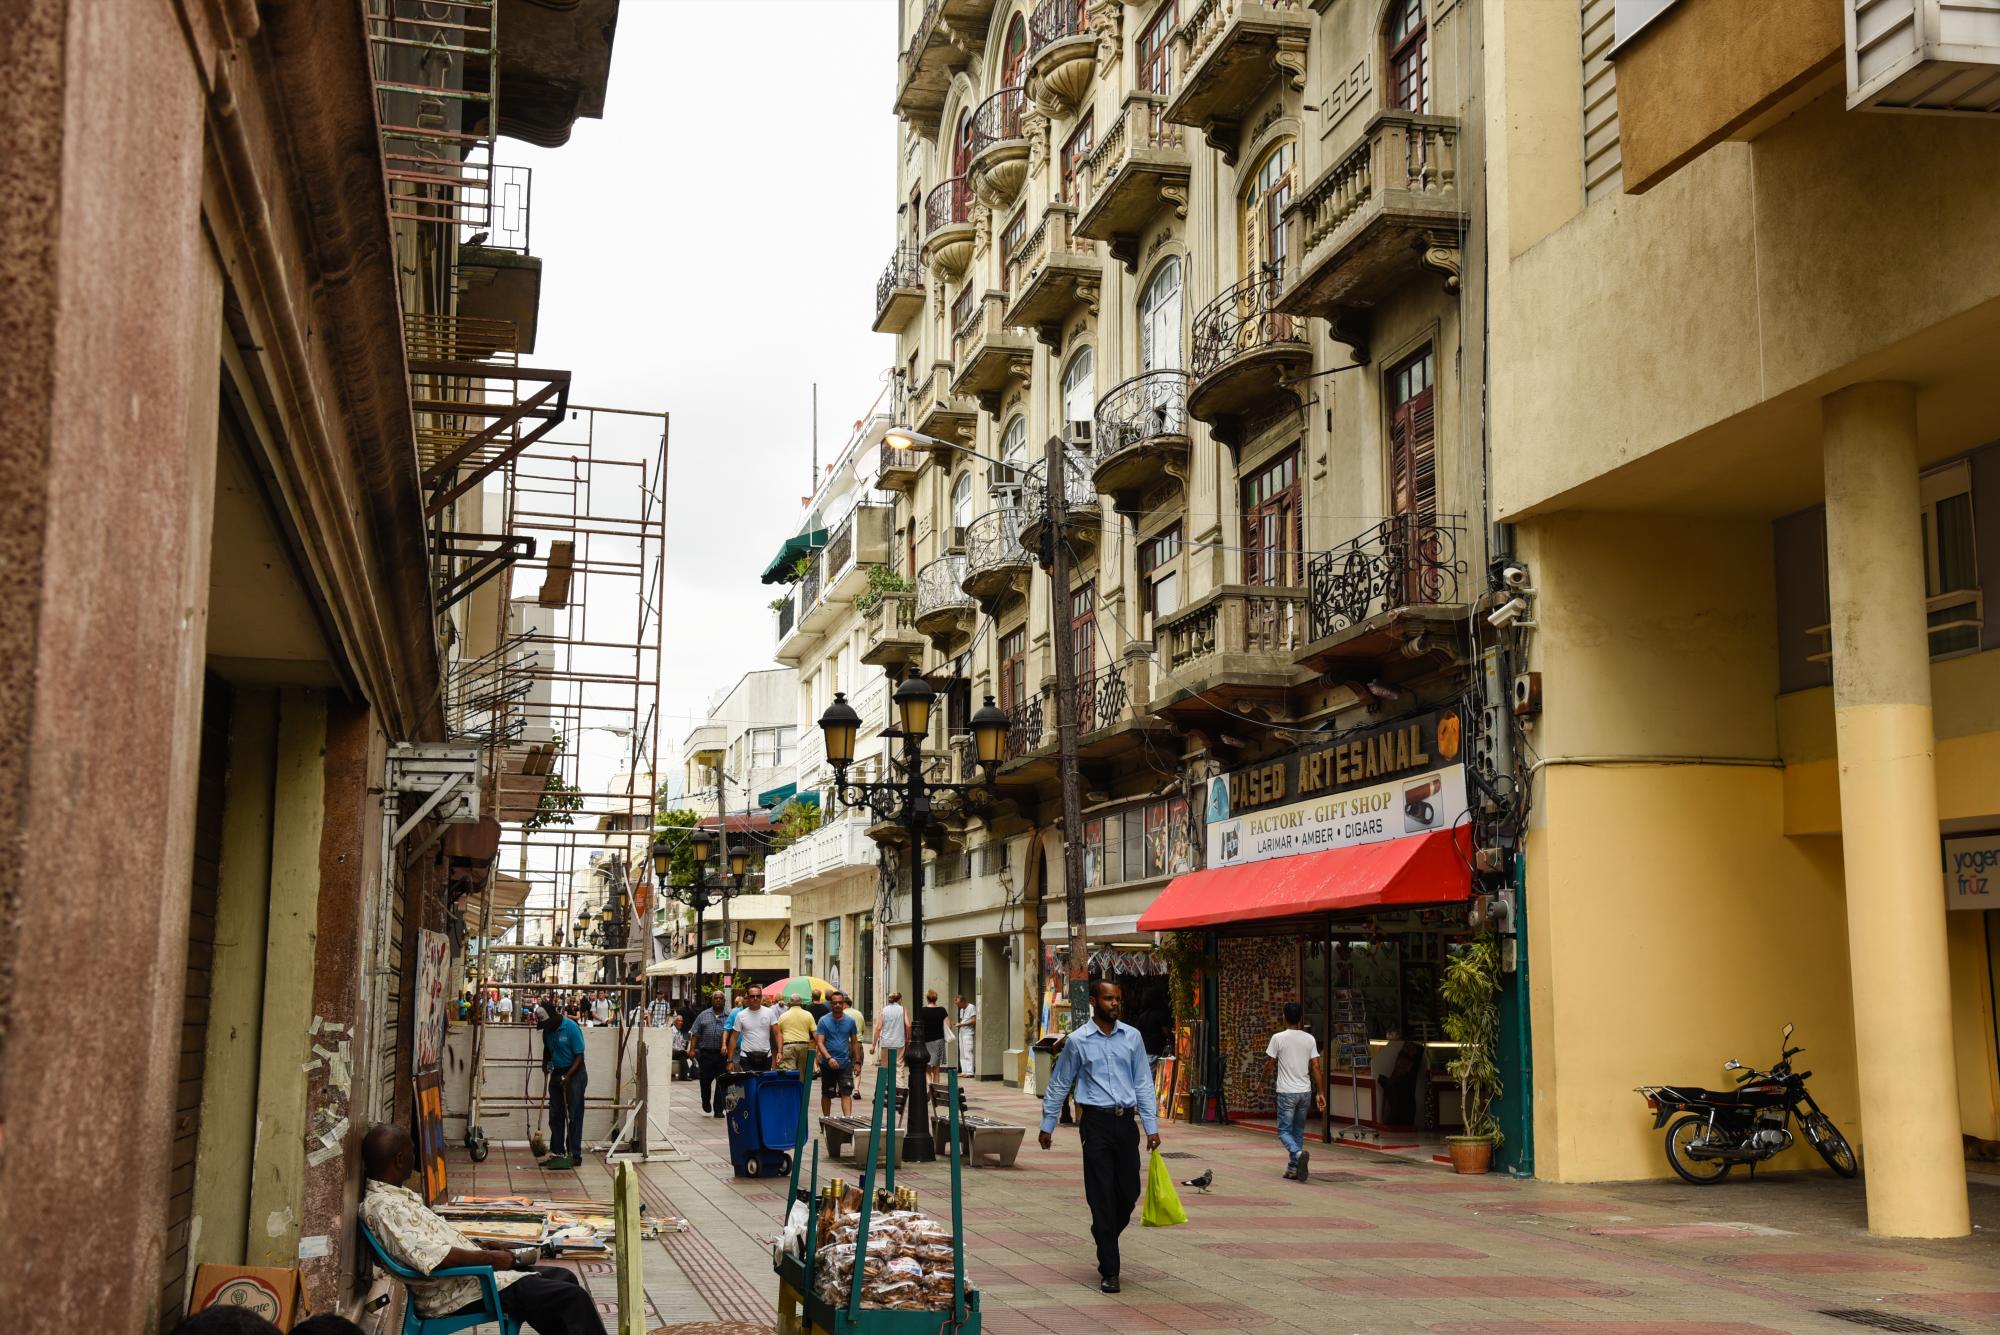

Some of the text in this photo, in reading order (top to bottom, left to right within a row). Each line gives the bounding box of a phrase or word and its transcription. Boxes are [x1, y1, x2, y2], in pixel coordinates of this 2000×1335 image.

[1297, 724, 1429, 793] ARTESANAL
[1250, 809, 1305, 836] FACTORY
[1314, 800, 1348, 823] GIFT
[1351, 791, 1392, 816] SHOP
[1257, 818, 1383, 854] LARIMAR AMBER CIGARS
